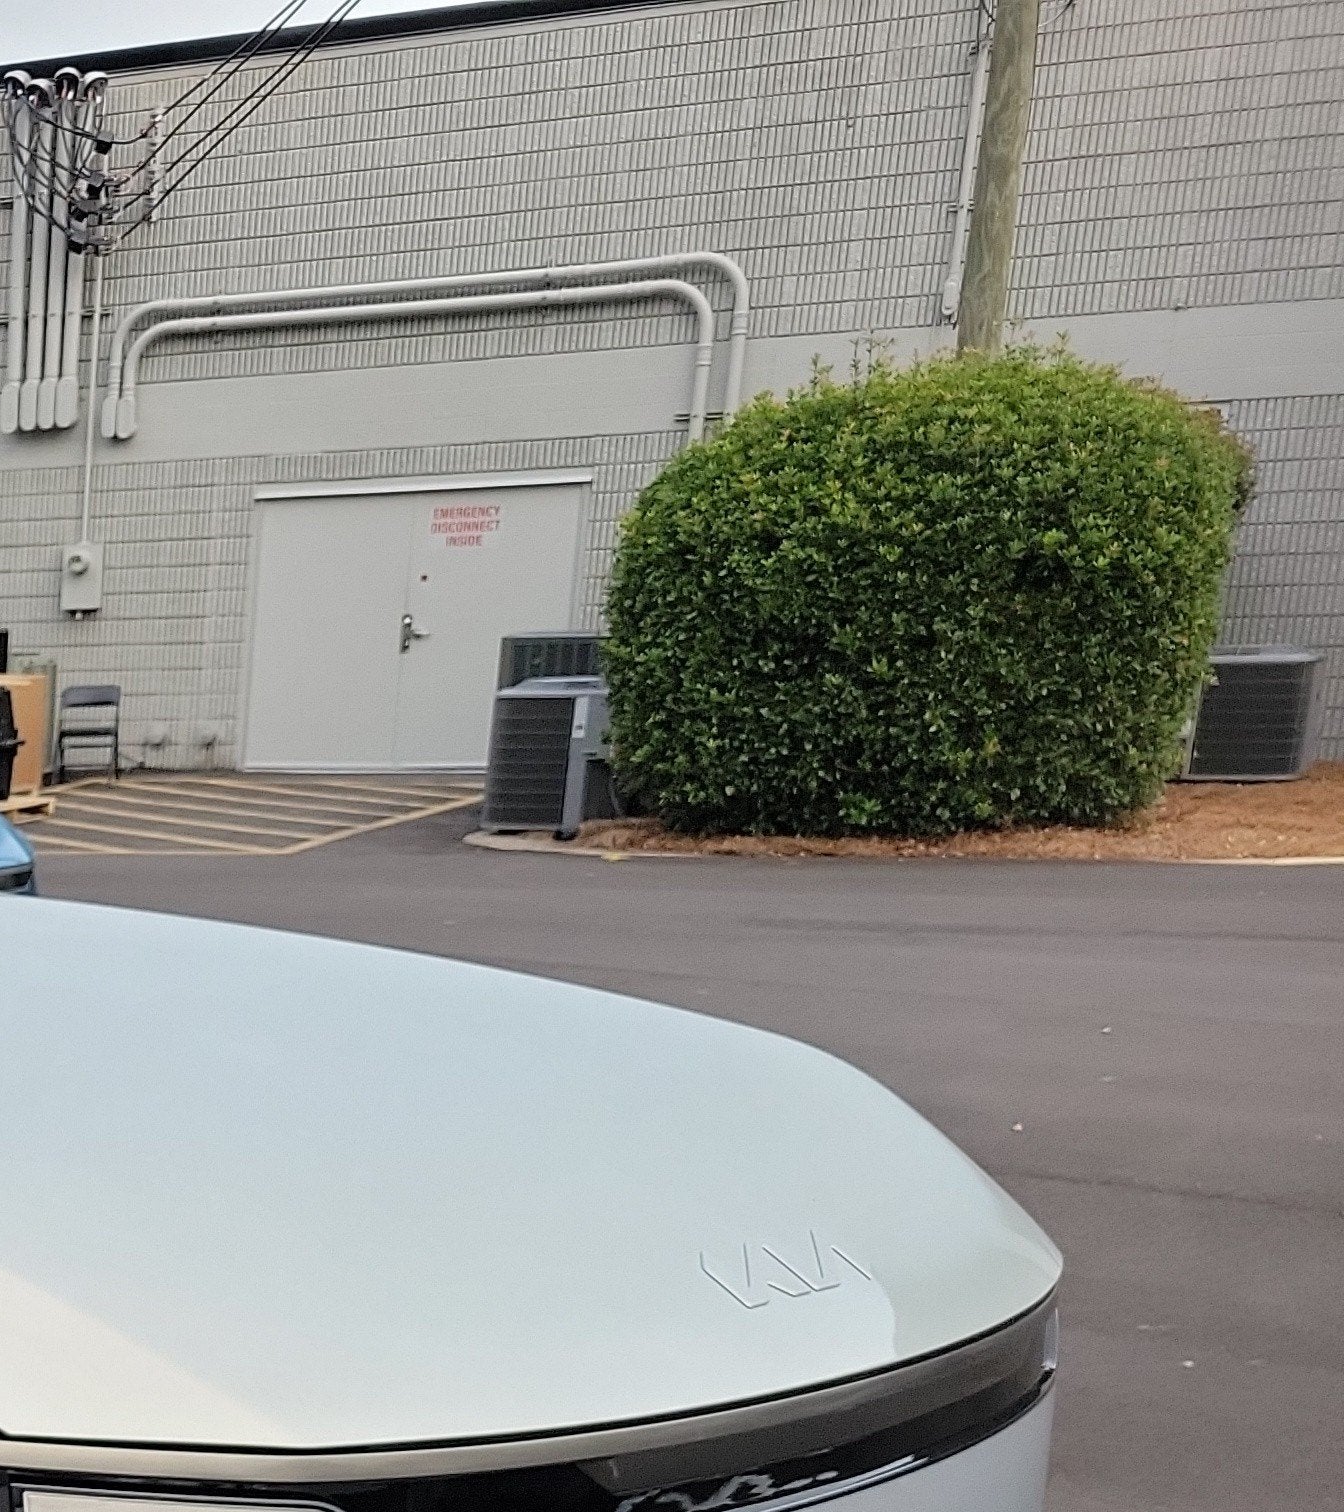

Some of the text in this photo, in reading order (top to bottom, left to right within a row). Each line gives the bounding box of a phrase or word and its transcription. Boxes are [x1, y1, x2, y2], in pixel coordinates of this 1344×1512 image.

[433, 505, 500, 519] EMERGENCY
[431, 519, 500, 534] DISCONNECT
[445, 534, 483, 547] INSIDE
